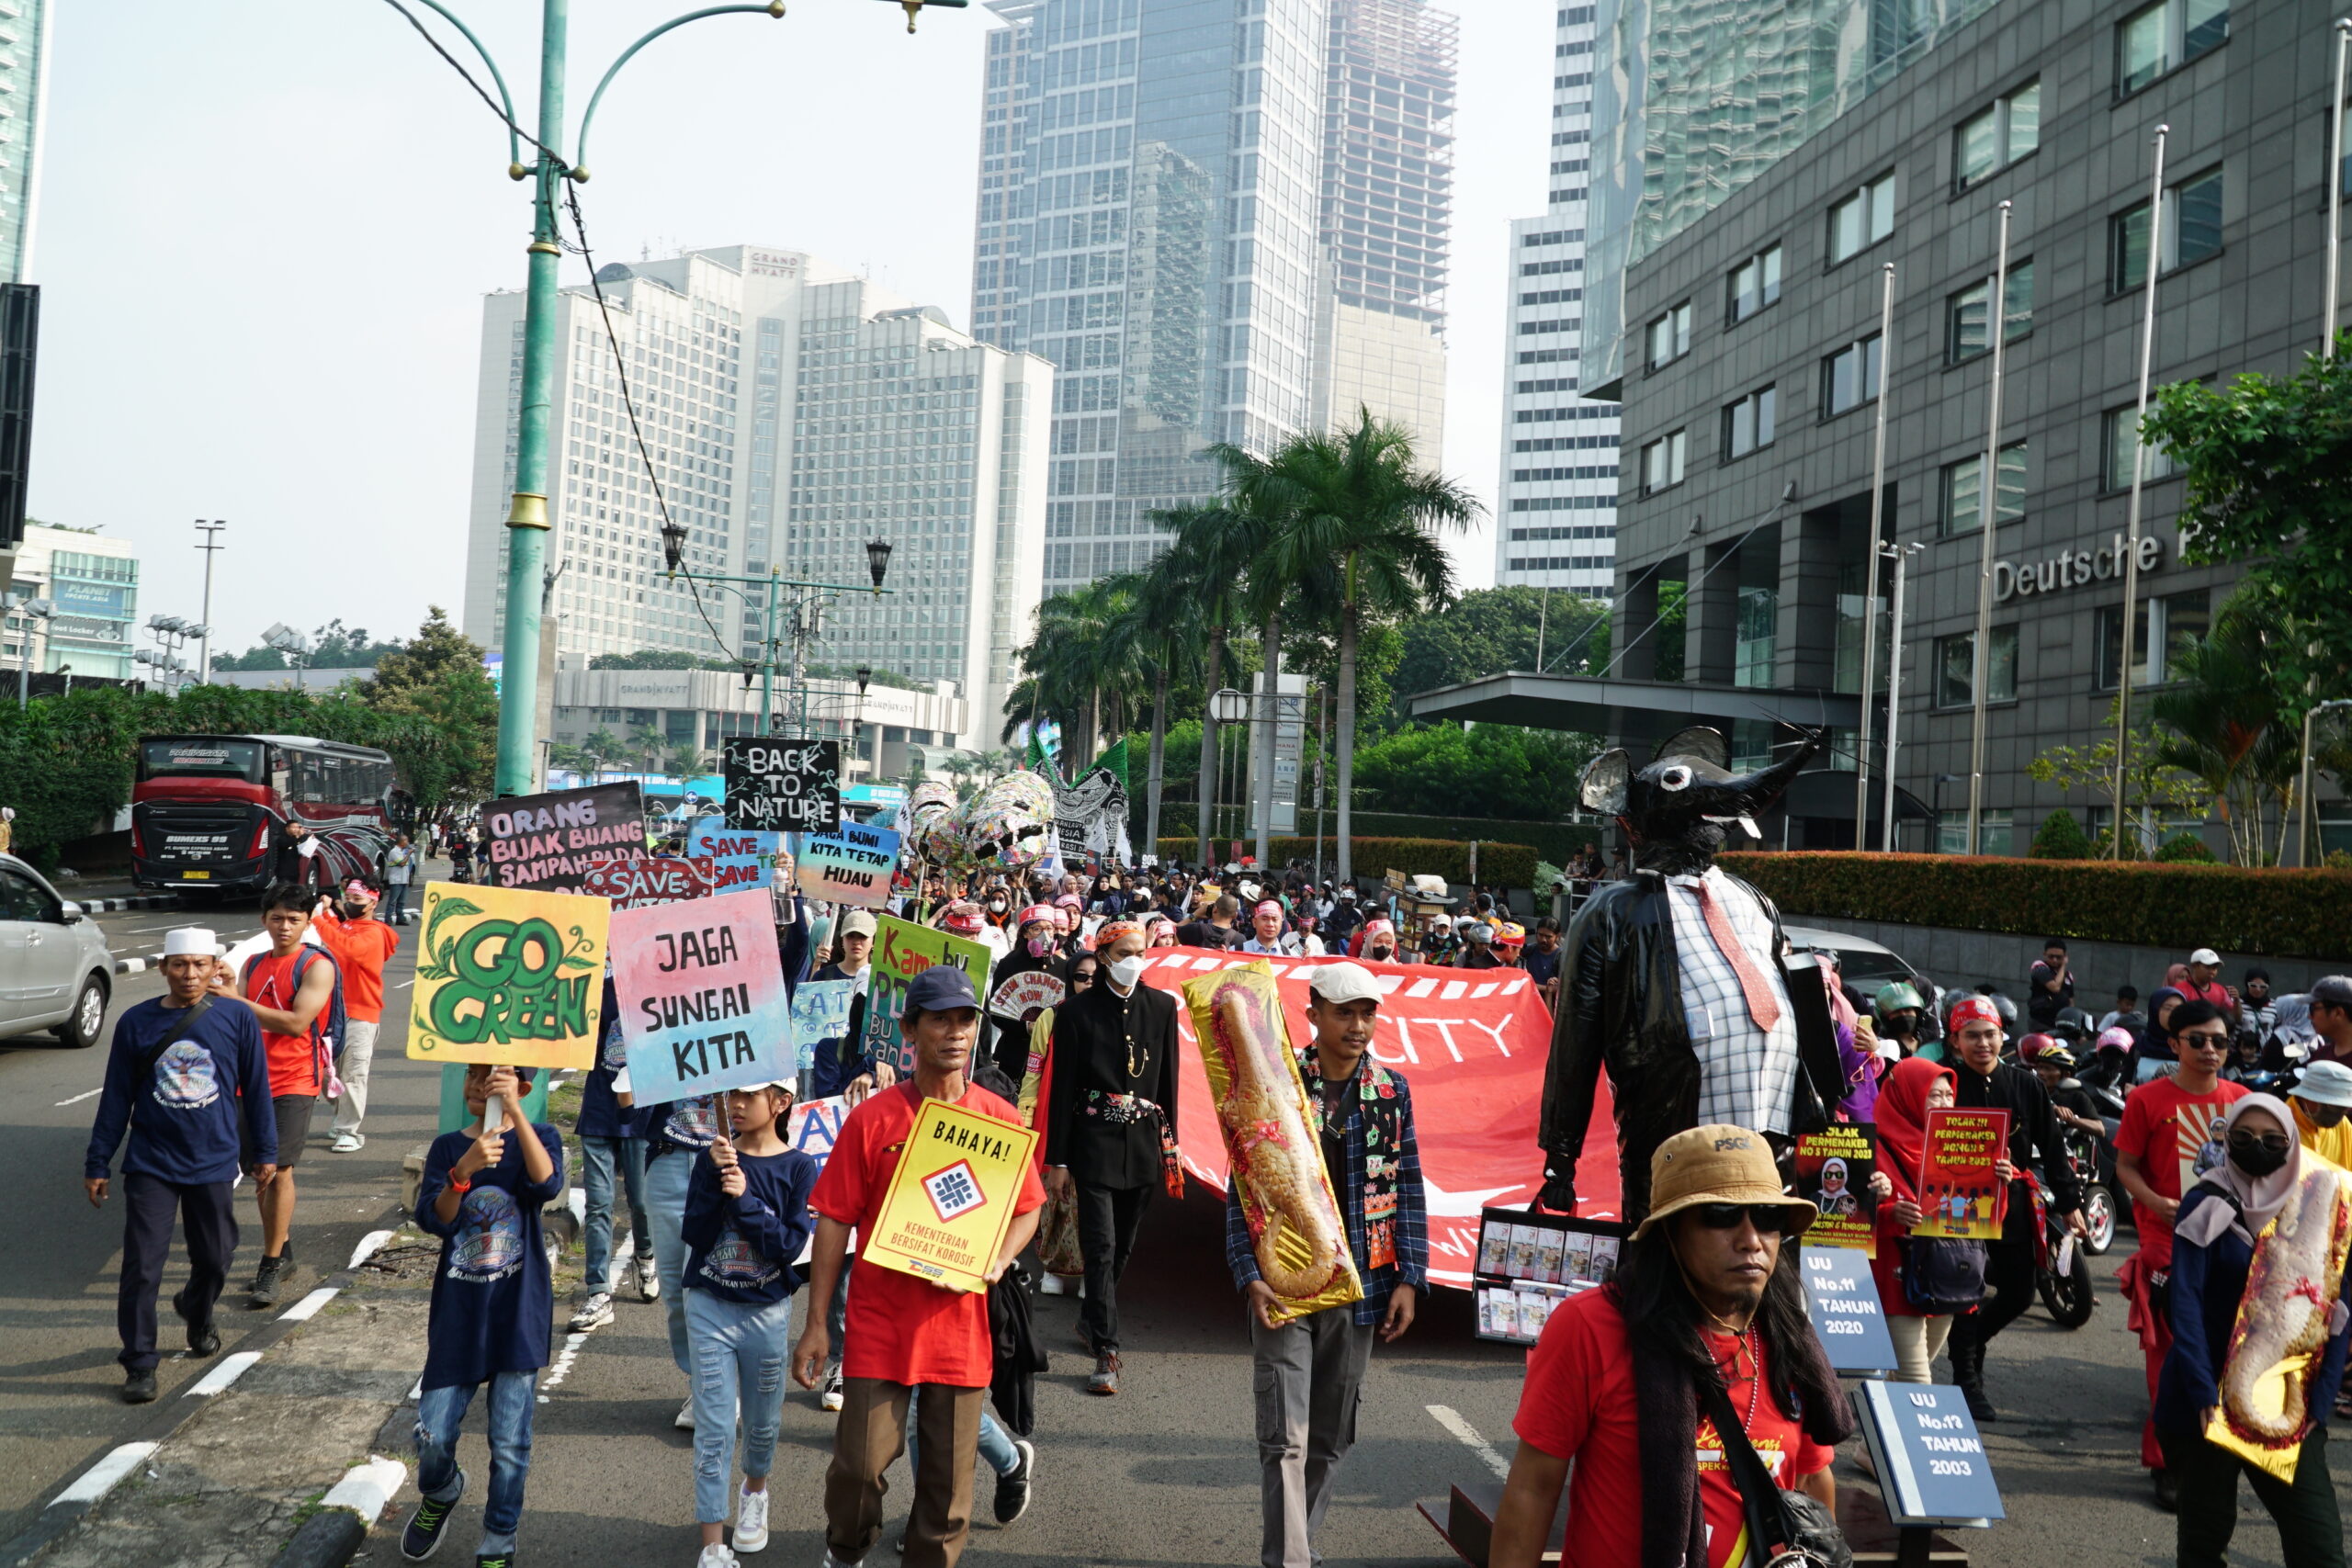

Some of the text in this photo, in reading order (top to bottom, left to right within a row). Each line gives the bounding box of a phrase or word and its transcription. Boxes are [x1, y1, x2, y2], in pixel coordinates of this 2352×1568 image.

[751, 252, 797, 265] GRAND
[751, 266, 795, 279] HYATT
[1993, 532, 2160, 604] Deutsche
[67, 584, 111, 596] PLANET
[69, 626, 95, 635] Locker
[748, 747, 821, 776] BACK
[763, 774, 801, 795] TO
[491, 797, 598, 840] ORANG
[739, 797, 834, 823] NATURE
[166, 835, 209, 843] BUMEKS
[491, 819, 643, 863] BIJAK BUANG
[699, 836, 758, 860] SAVE
[848, 829, 879, 848] BUMI
[809, 841, 890, 868] KITA TETAP
[1141, 853, 1158, 866] 90%
[500, 854, 588, 888] SAMPAH
[714, 864, 760, 889] SAVE
[822, 864, 874, 889] HIJAU
[609, 871, 684, 899] SAVE
[454, 917, 565, 989] GO
[655, 924, 740, 973] JAGA
[1023, 972, 1064, 995] CHANGE
[1019, 989, 1043, 1003] NOW
[429, 973, 592, 1045] GREEN
[641, 982, 752, 1033] SUNGAI
[672, 1030, 756, 1082] KITA
[1945, 1116, 1976, 1127] TOLAK
[933, 1120, 1012, 1163] BAHAYA!
[1805, 1136, 1869, 1148] PERMENAKER
[1935, 1129, 1996, 1141] PERMENAKER
[1800, 1145, 1814, 1156] NO
[1822, 1147, 1852, 1158] TAHUN
[1853, 1148, 1872, 1159] 2023
[1935, 1155, 1992, 1167] TAHUN 2023
[904, 1221, 968, 1250] KEMENTERIAN
[890, 1232, 977, 1268] BERSIFAT KOROSIF
[1807, 1256, 1832, 1271] UU
[1814, 1277, 1856, 1292] No.11
[1818, 1298, 1876, 1314] TAHUN
[1825, 1320, 1864, 1335] 2020
[1908, 1393, 1937, 1408] UU
[1917, 1414, 1963, 1429] No.13
[1920, 1436, 1982, 1454] TAHUN
[1930, 1460, 1973, 1477] 2003
